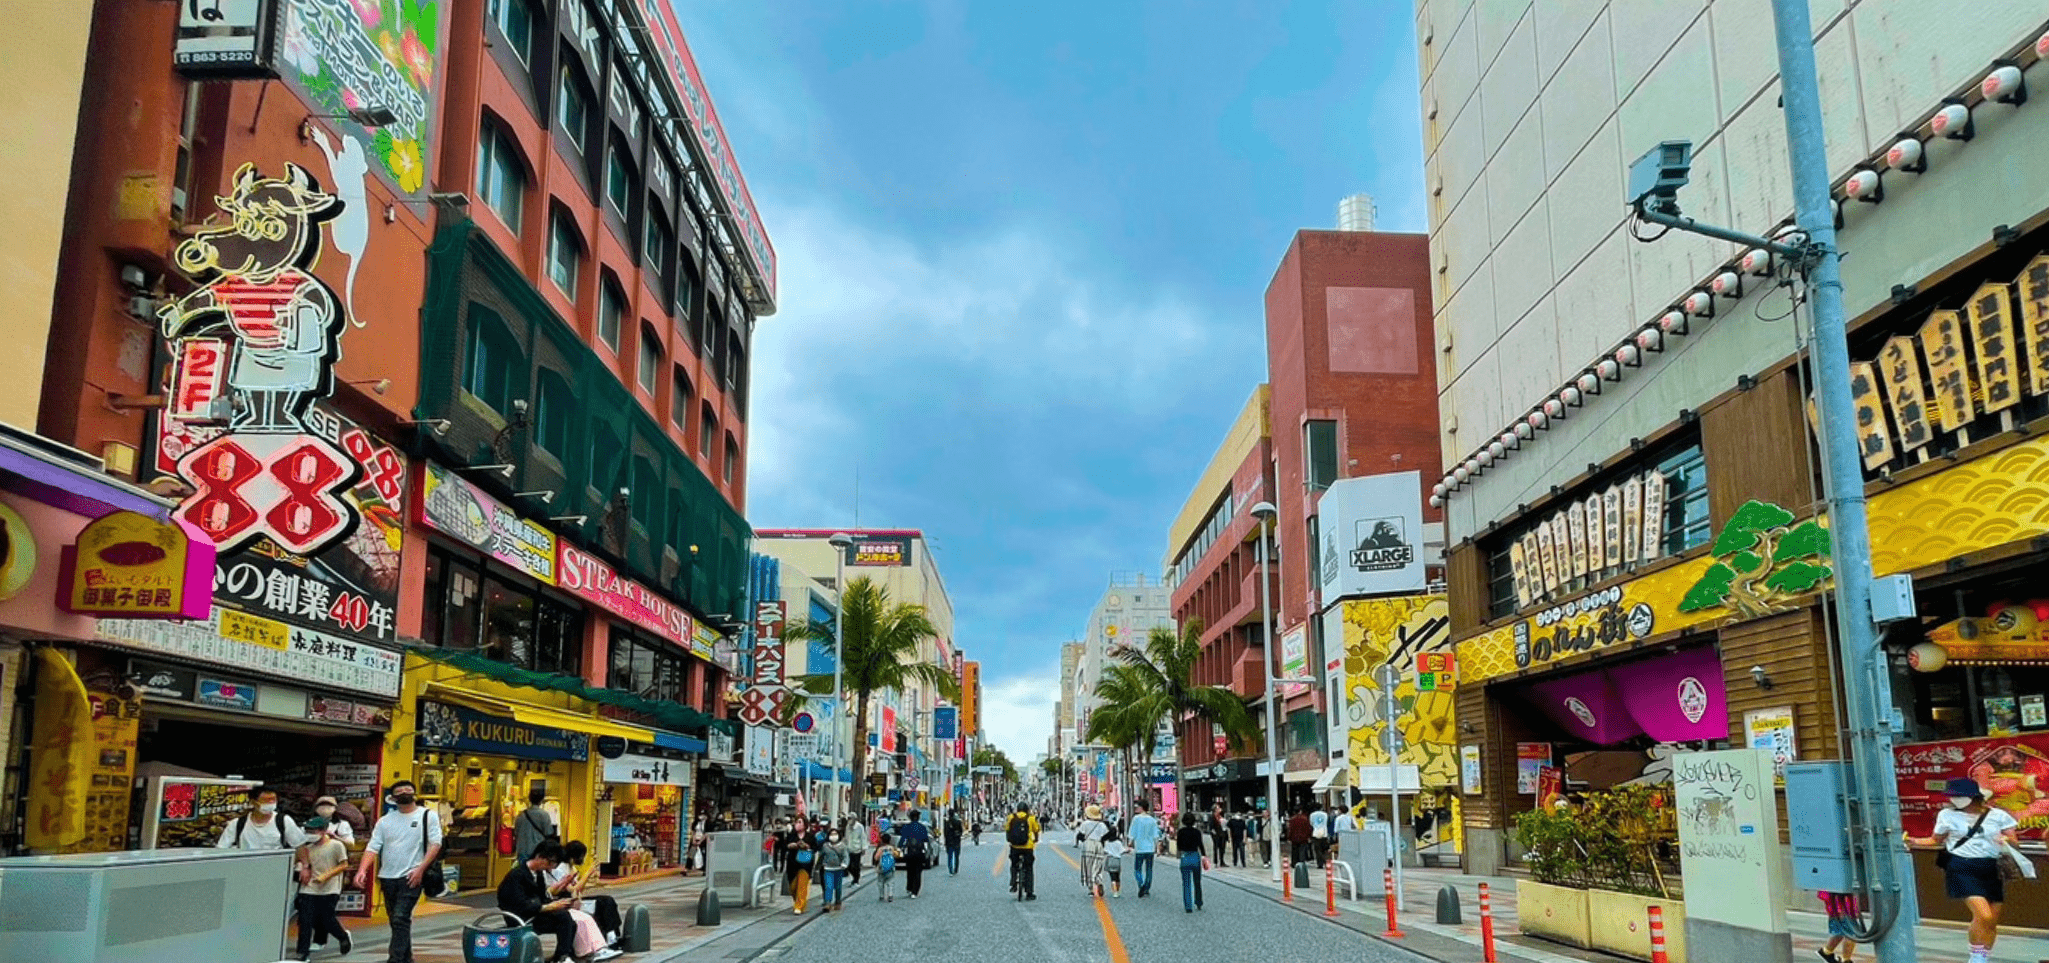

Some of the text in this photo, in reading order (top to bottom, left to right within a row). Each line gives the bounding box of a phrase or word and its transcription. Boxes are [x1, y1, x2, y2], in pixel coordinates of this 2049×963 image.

[183, 348, 218, 413] 2F
[182, 440, 345, 547] 88
[1353, 547, 1411, 565] XLARGE
[213, 563, 395, 640] の創業40年
[561, 547, 635, 602] STEAK
[640, 589, 691, 646] HOUSE
[290, 630, 357, 663] 家庭料理
[1442, 673, 1451, 683] P
[467, 720, 536, 746] KUKURU
